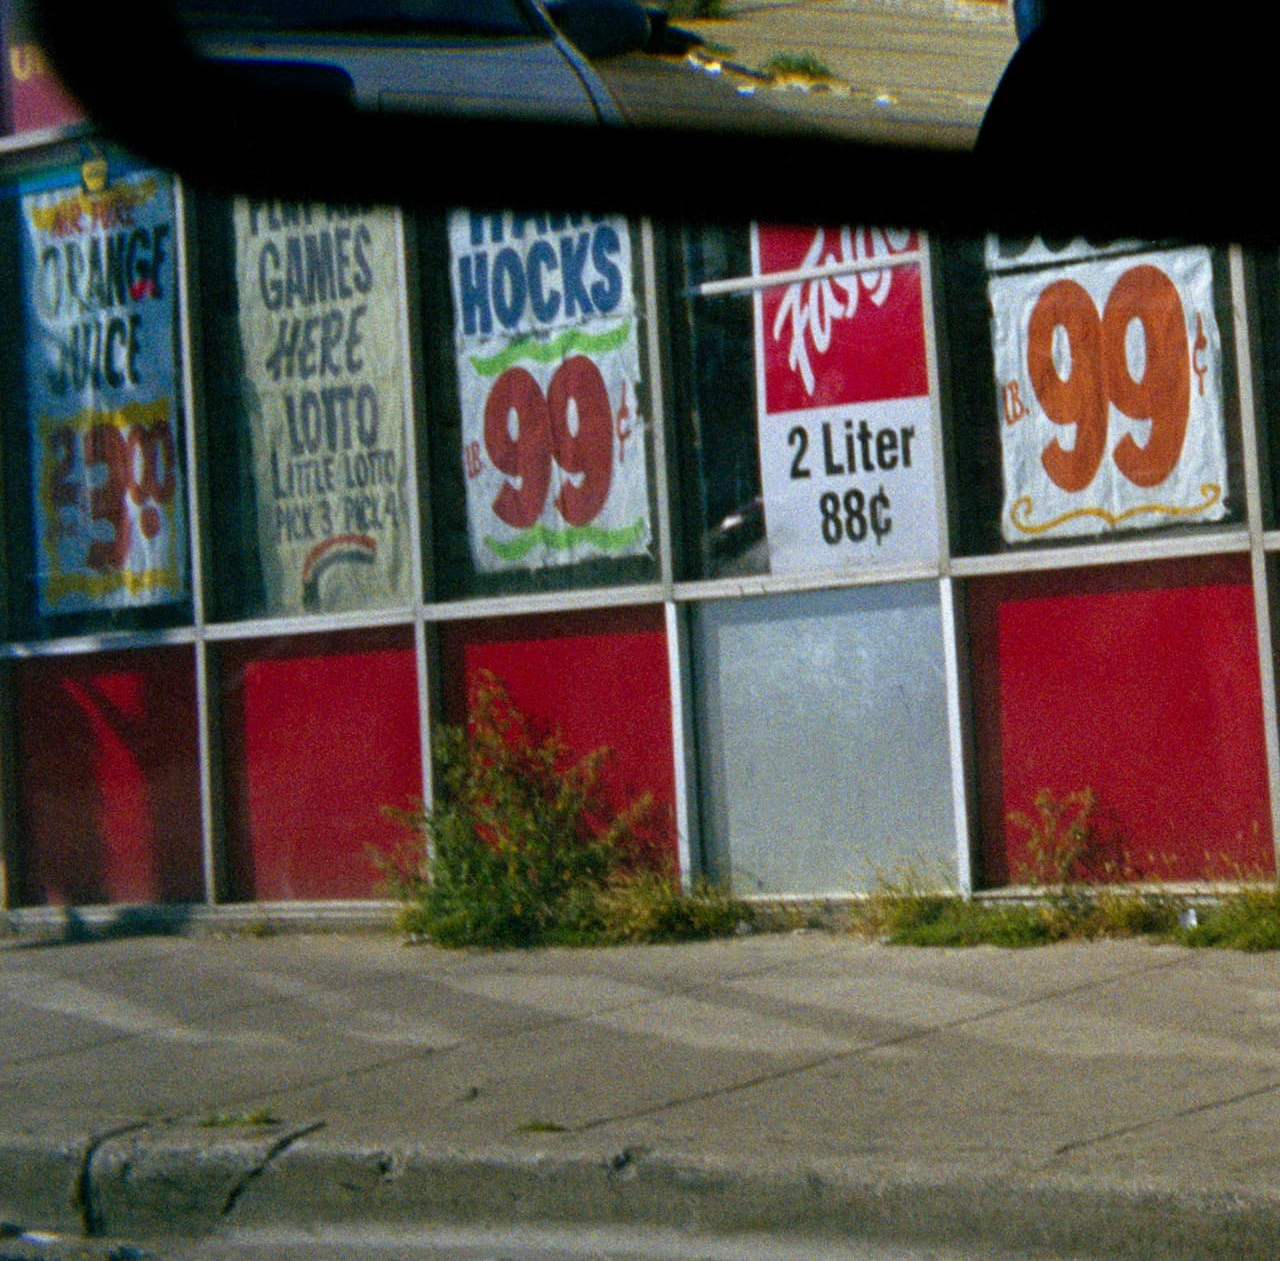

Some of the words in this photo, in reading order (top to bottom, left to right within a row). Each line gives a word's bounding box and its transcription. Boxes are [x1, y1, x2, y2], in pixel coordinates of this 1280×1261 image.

[258, 223, 373, 311] GAMES
[458, 224, 623, 336] HOCKS
[266, 304, 368, 380] HERE
[284, 382, 379, 454] LOTTO
[787, 425, 811, 479] 2
[821, 418, 915, 477] Liter
[270, 441, 334, 500] LITTLE
[344, 448, 397, 489] LOTTO
[319, 499, 334, 537] 3
[819, 484, 893, 546] 88¢
